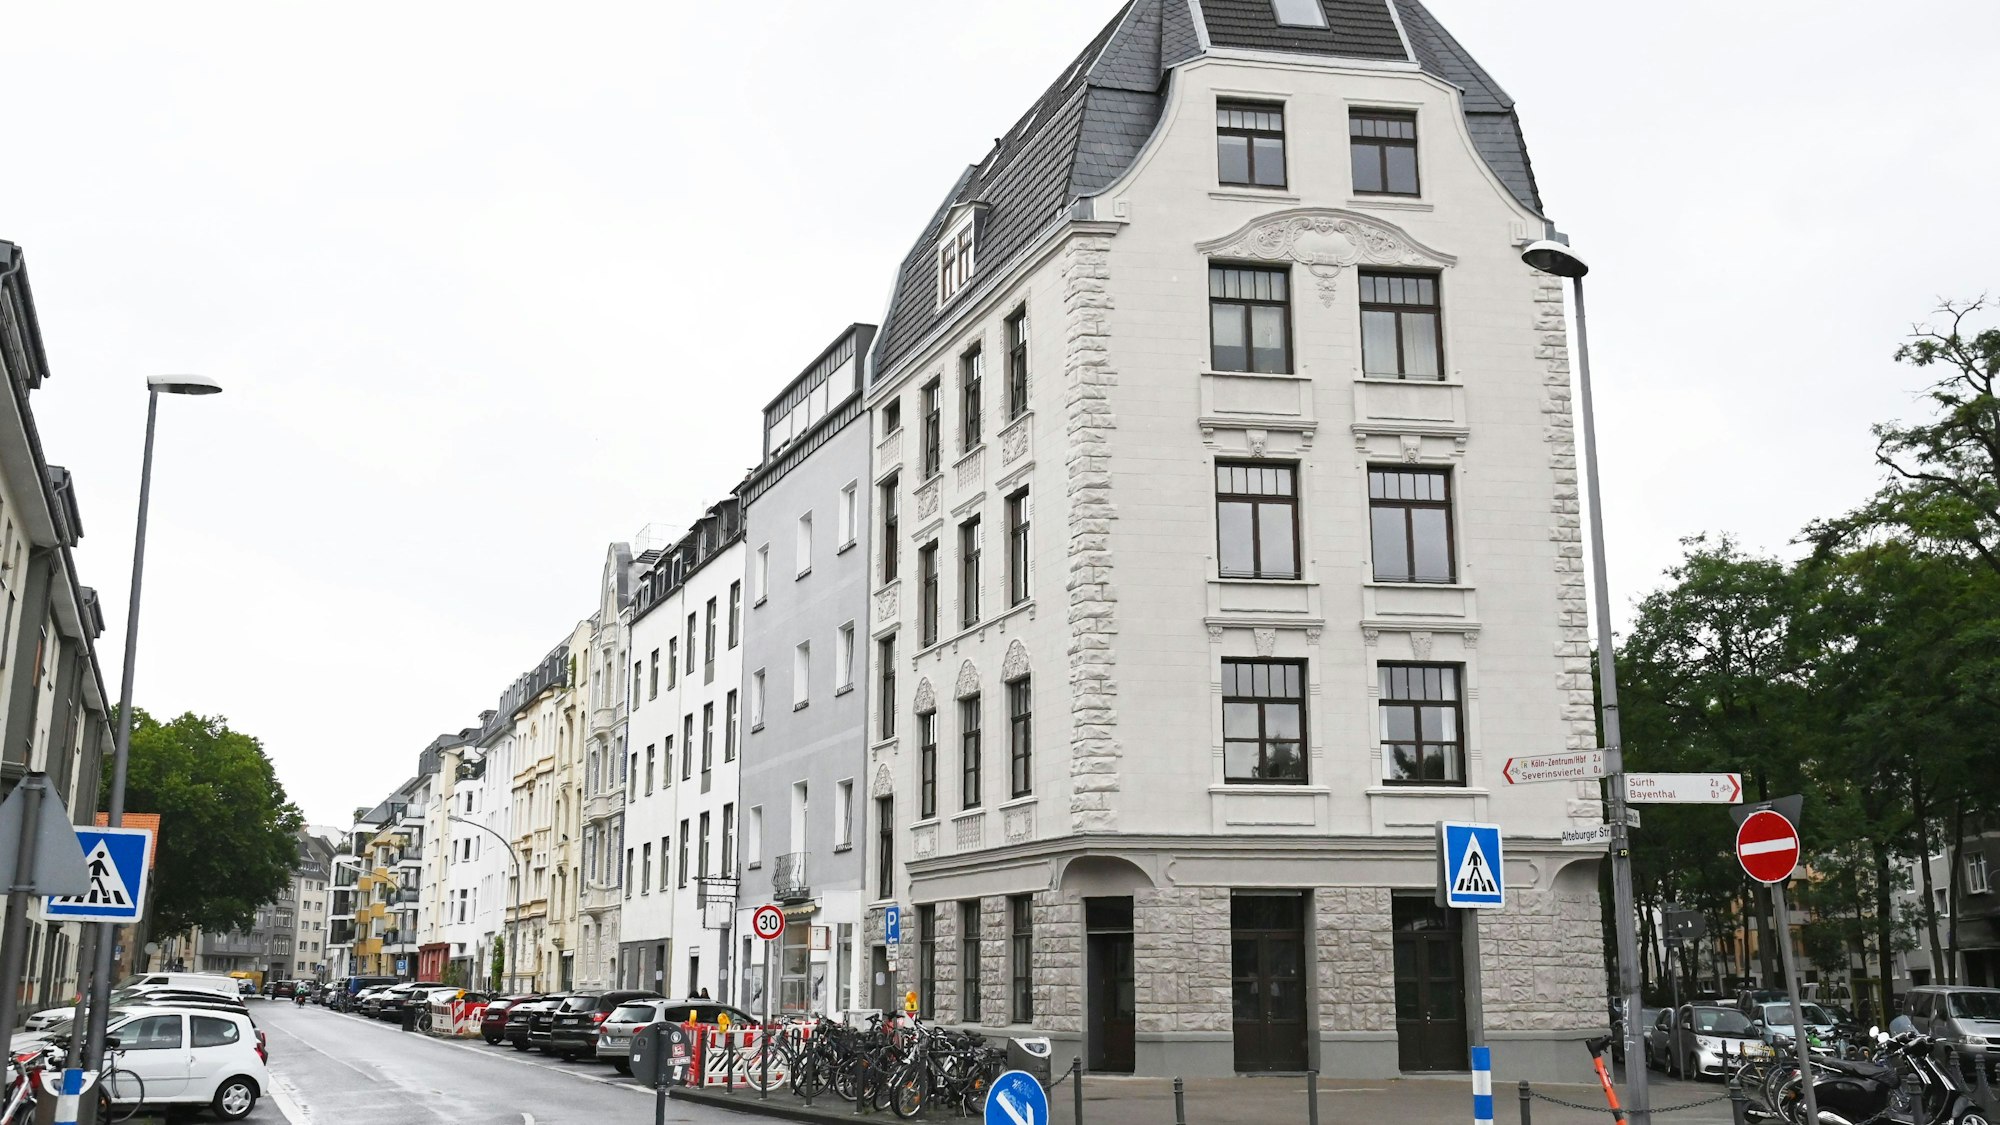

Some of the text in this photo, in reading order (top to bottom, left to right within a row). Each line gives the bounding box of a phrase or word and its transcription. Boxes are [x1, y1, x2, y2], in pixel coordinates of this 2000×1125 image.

[1531, 755, 1587, 768] Köln-Zentrum/Hbf
[1521, 768, 1585, 780] Severinsviertel
[1629, 778, 1655, 787] Sürth
[1629, 789, 1677, 800] Bayenthal
[1562, 830, 1598, 841] Alteburger
[759, 914, 778, 931] 30
[887, 911, 897, 935] P
